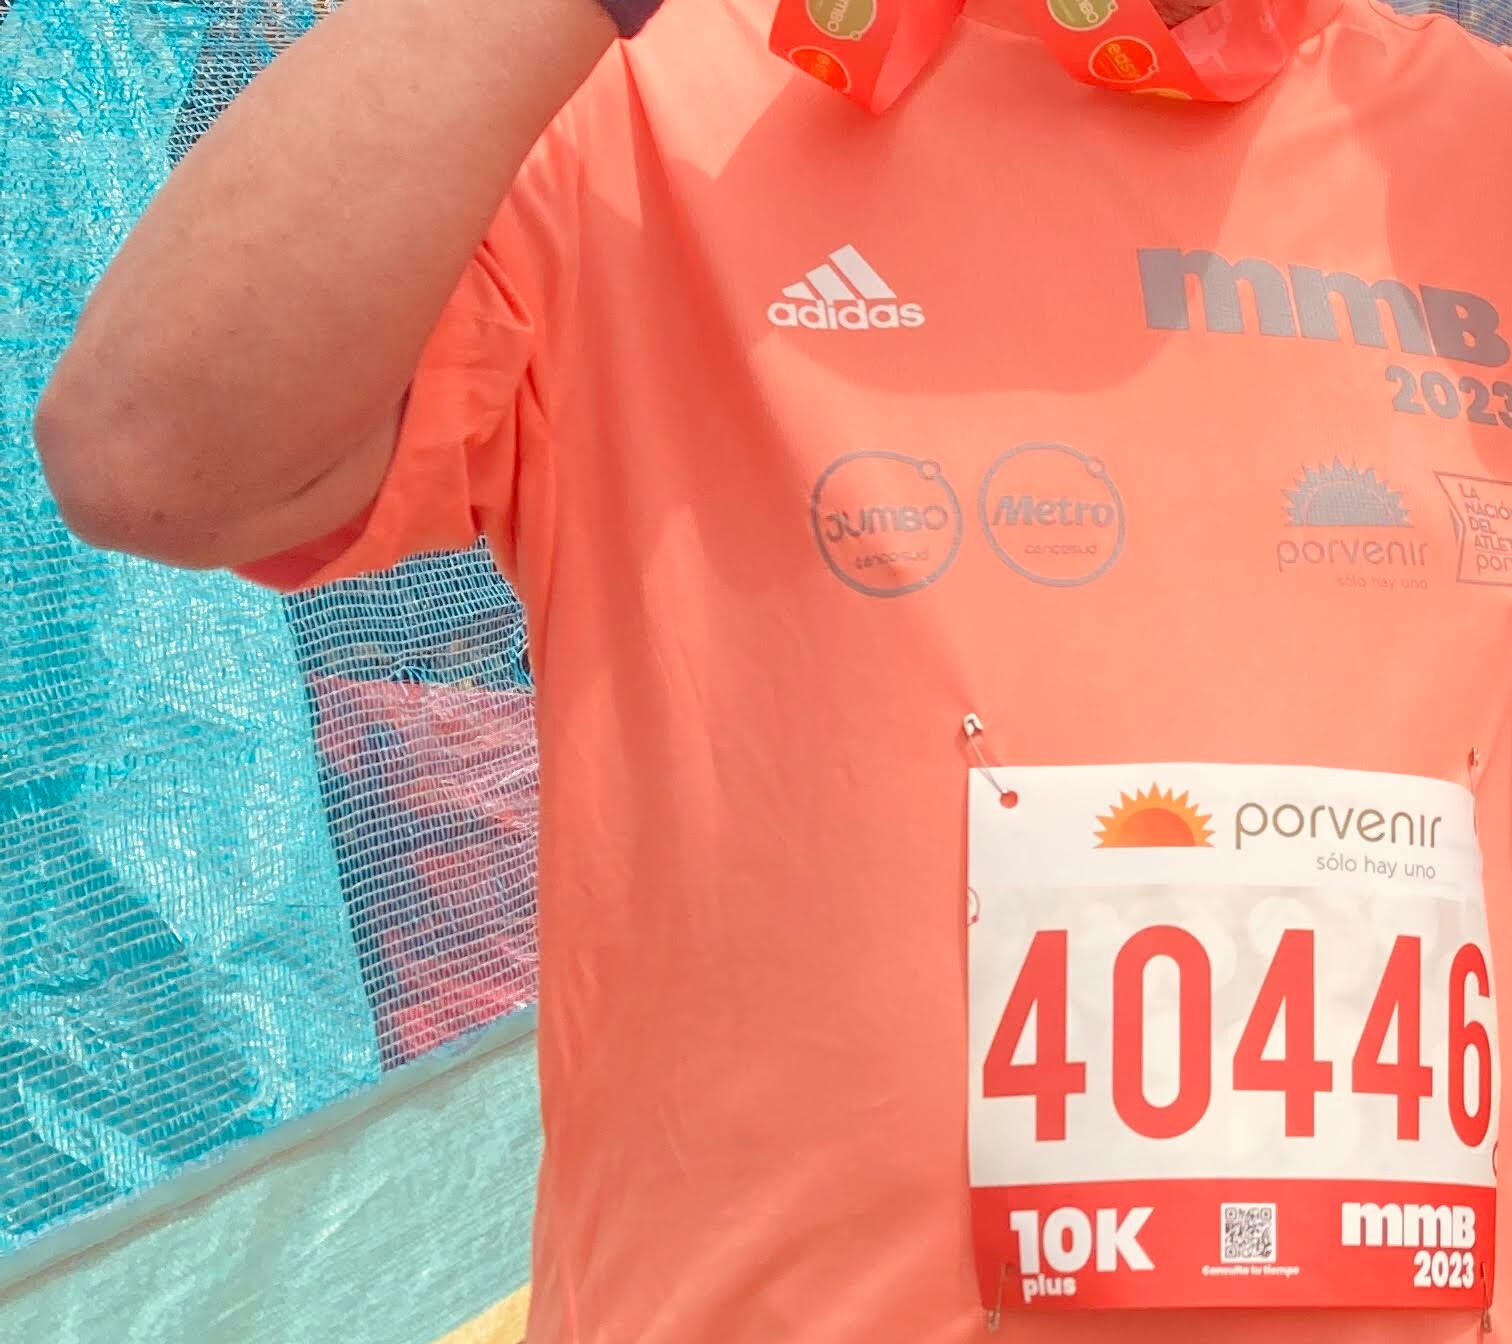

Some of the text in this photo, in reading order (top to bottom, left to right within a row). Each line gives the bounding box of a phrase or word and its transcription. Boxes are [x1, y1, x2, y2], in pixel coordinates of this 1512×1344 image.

[767, 298, 926, 331] adidas
[1137, 248, 1511, 367] mmB
[1458, 483, 1480, 500] LA
[993, 495, 1116, 528] Metro
[1468, 516, 1496, 534] DEL
[1276, 539, 1429, 573] porvenir
[1235, 801, 1443, 850] porvenir
[1316, 852, 1437, 881] sólo hay uno
[982, 924, 1493, 1148] 40446
[1010, 1206, 1156, 1275] 10K
[1341, 1202, 1475, 1248] mmB
[1414, 1251, 1475, 1289] 2023
[1022, 1273, 1077, 1303] plus
